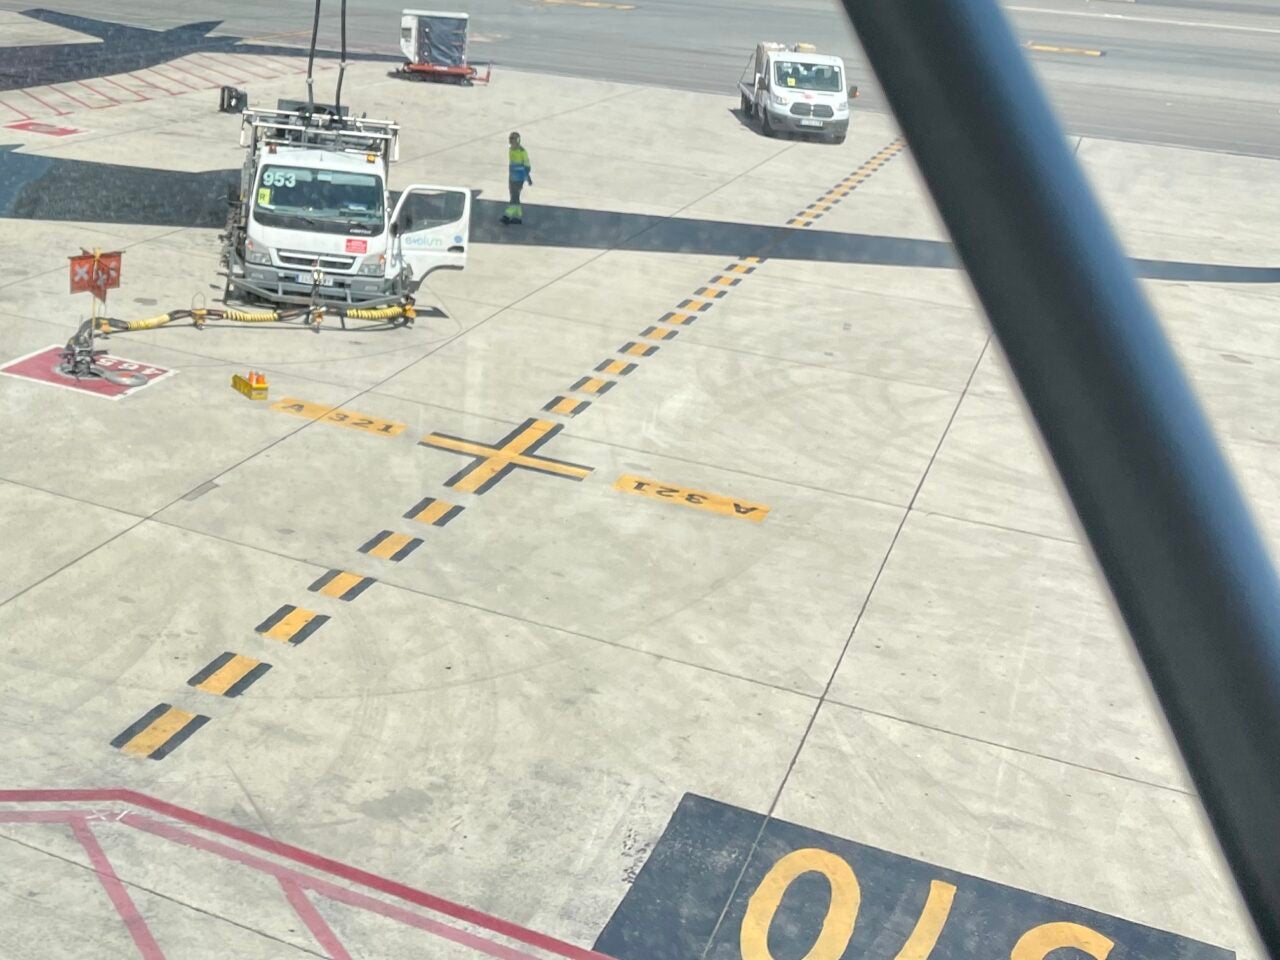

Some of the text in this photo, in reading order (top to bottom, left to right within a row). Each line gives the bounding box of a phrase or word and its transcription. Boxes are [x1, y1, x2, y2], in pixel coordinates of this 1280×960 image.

[263, 171, 296, 188] 953
[328, 413, 393, 433] 321
[631, 481, 708, 504] 321
